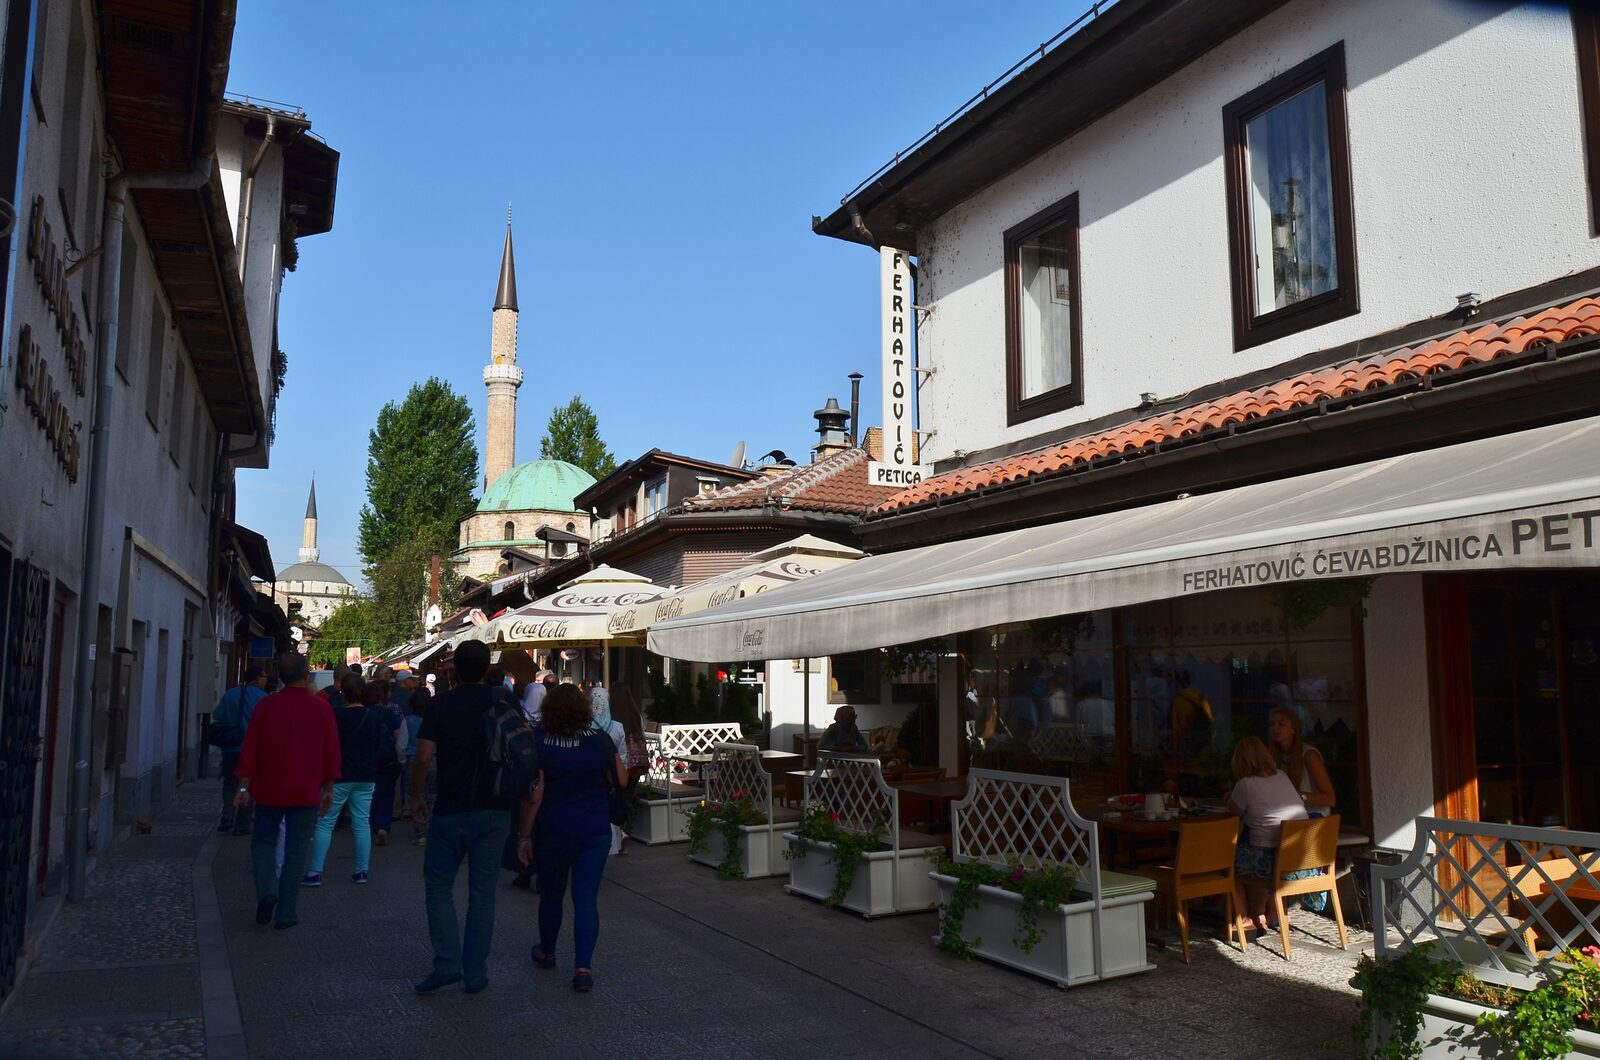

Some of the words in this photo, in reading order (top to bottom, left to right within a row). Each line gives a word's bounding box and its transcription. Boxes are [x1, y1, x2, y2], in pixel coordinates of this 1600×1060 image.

[892, 252, 905, 465] FERHATOVIĆ
[877, 468, 921, 485] PETICA
[1183, 552, 1306, 592] FERHATOVIĆ
[1313, 533, 1504, 576] ĆEVABDŽINICA
[1511, 509, 1600, 555] PET
